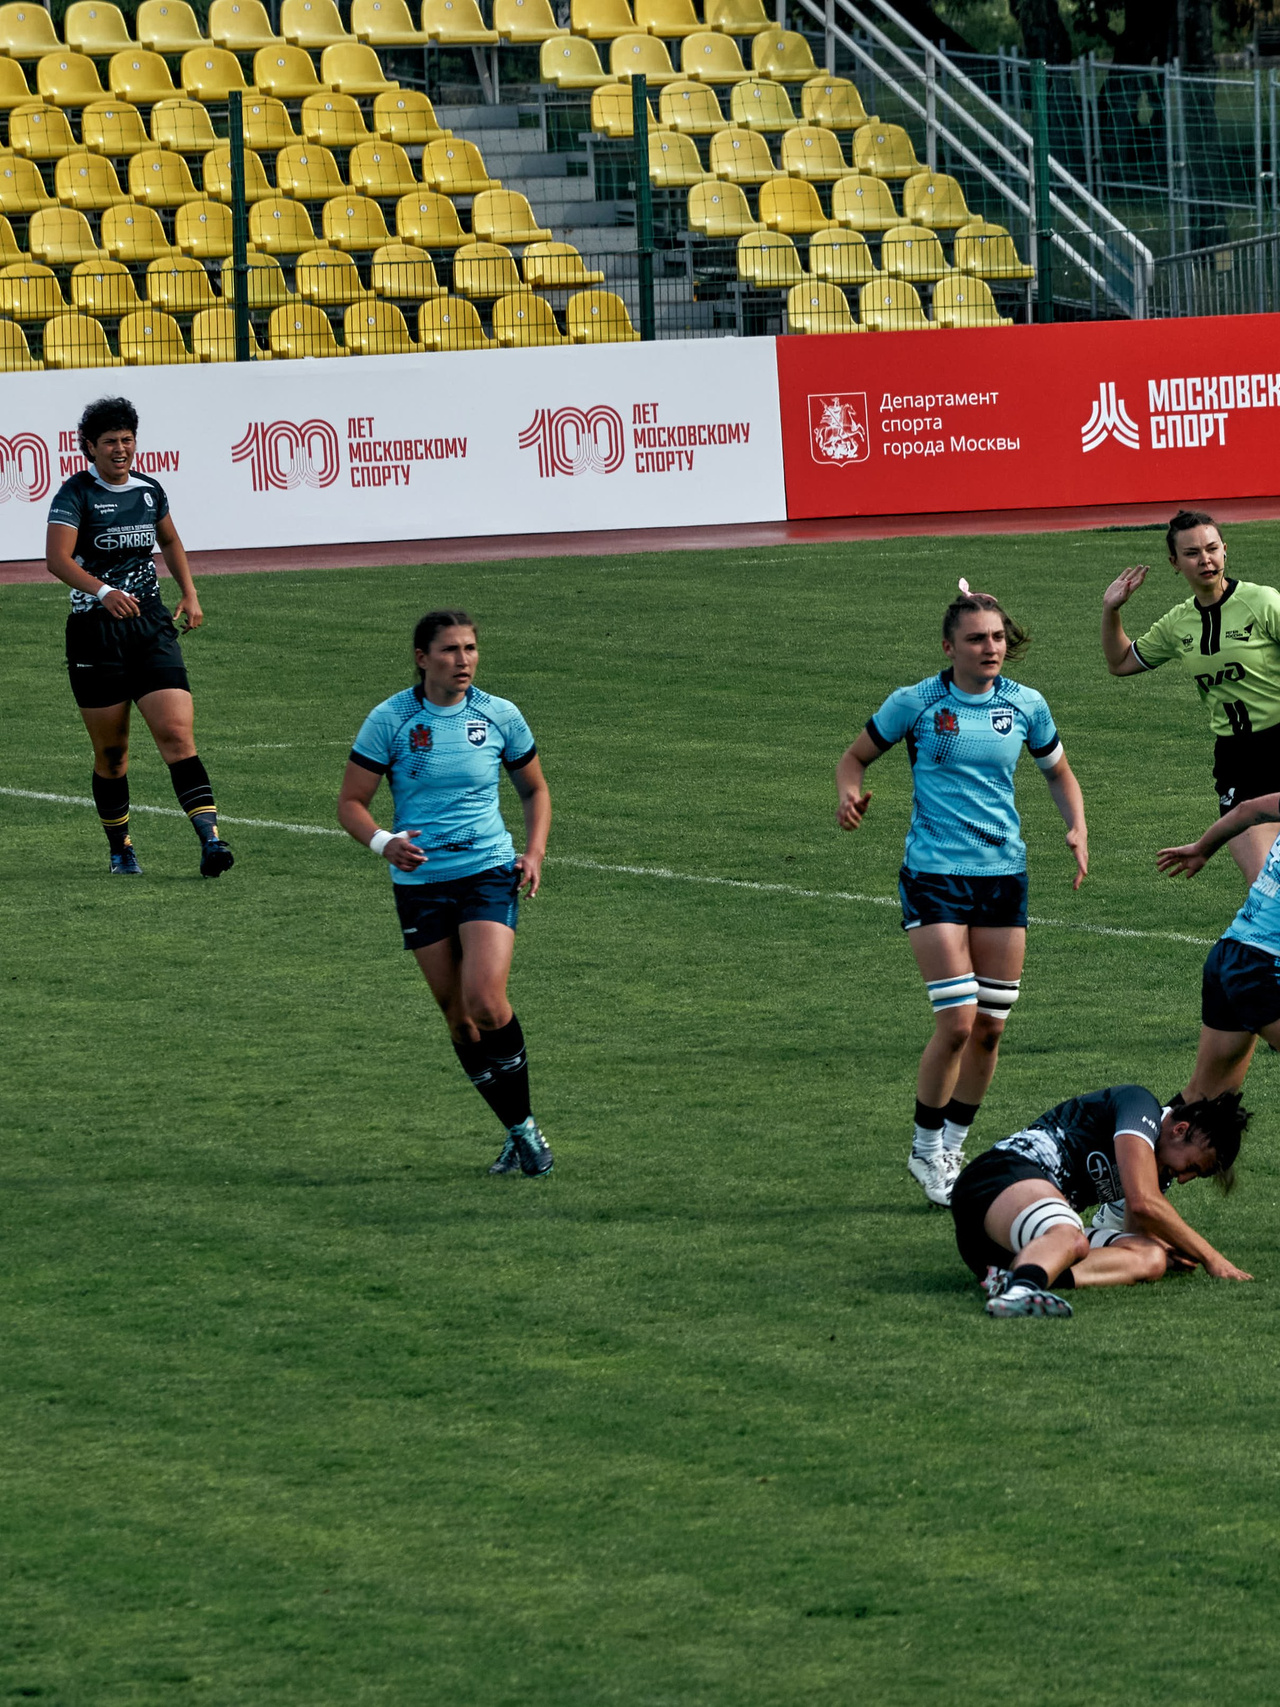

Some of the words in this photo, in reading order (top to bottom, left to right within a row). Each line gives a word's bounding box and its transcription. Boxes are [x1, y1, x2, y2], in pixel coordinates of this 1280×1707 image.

[633, 403, 659, 424] ЛЕТ
[879, 391, 999, 413] Департамент
[348, 417, 374, 438] ЛЕТ
[634, 424, 750, 448] МОСКОВСКОМУ
[881, 416, 943, 436] спорта
[1150, 412, 1229, 449] СПОРТ
[349, 438, 467, 463] МОСКОВСКОМУ
[519, 404, 624, 477] 100
[883, 440, 945, 460] города
[950, 435, 1020, 453] Москвы
[231, 419, 340, 491] 100
[635, 451, 694, 474] СПОРТУ
[351, 464, 410, 487] СПОРТУ
